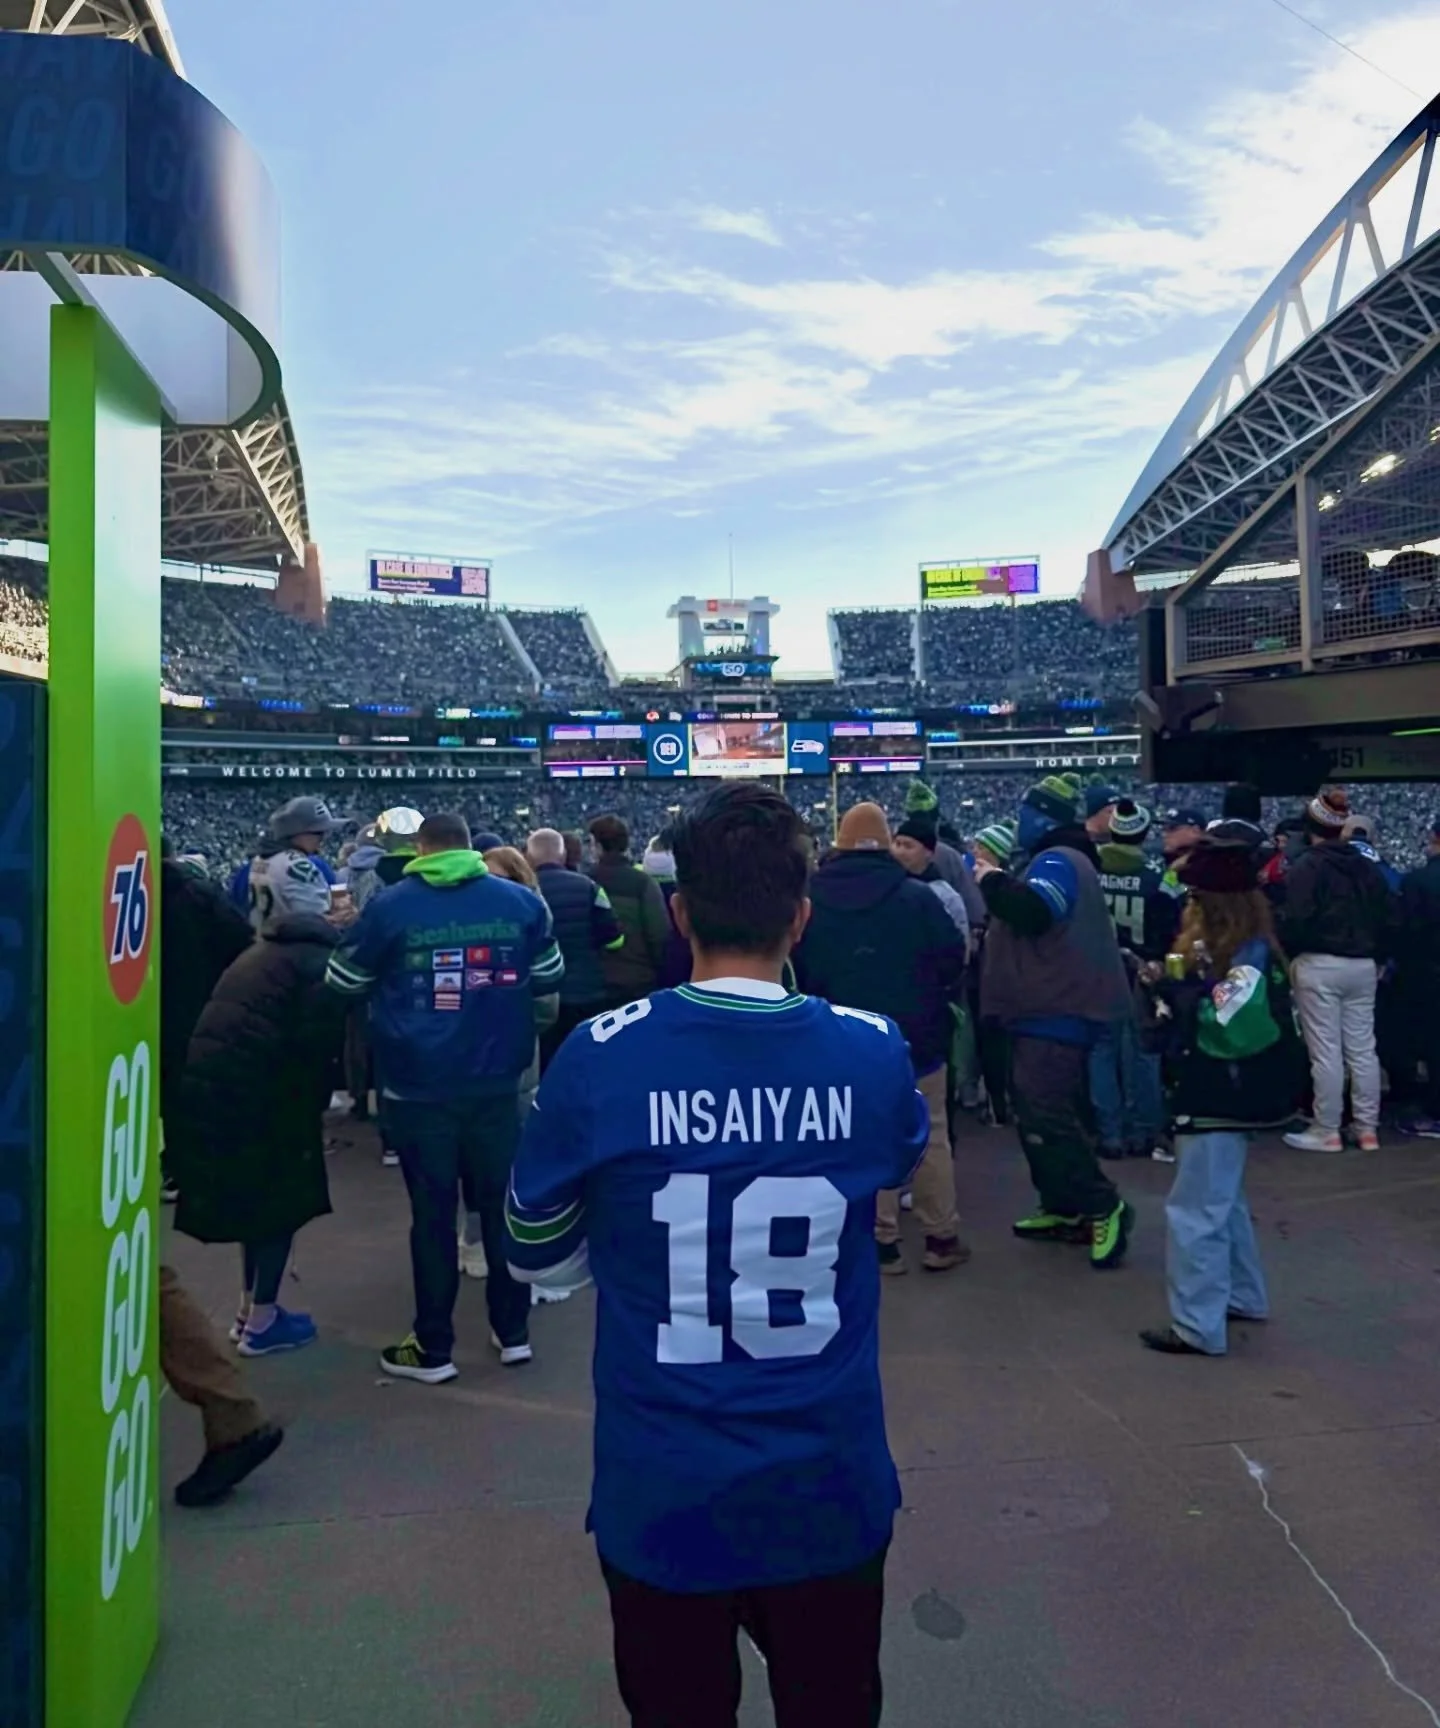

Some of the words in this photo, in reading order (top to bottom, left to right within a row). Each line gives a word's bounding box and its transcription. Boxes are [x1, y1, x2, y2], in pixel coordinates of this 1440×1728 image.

[222, 767, 312, 777] WELCOME
[324, 768, 346, 778] TO
[357, 768, 416, 778] LUMEN
[428, 768, 477, 778] FIELD
[1035, 757, 1084, 768] HOME
[1097, 756, 1117, 766] OF
[110, 850, 148, 964] 76
[1097, 873, 1141, 892] AGNER
[407, 919, 521, 947] Seahawks
[102, 1041, 150, 1229] GO
[649, 1086, 852, 1146] INSAIYAN
[102, 1207, 150, 1414] GO
[652, 1173, 848, 1364] 18
[101, 1375, 150, 1601] GO
